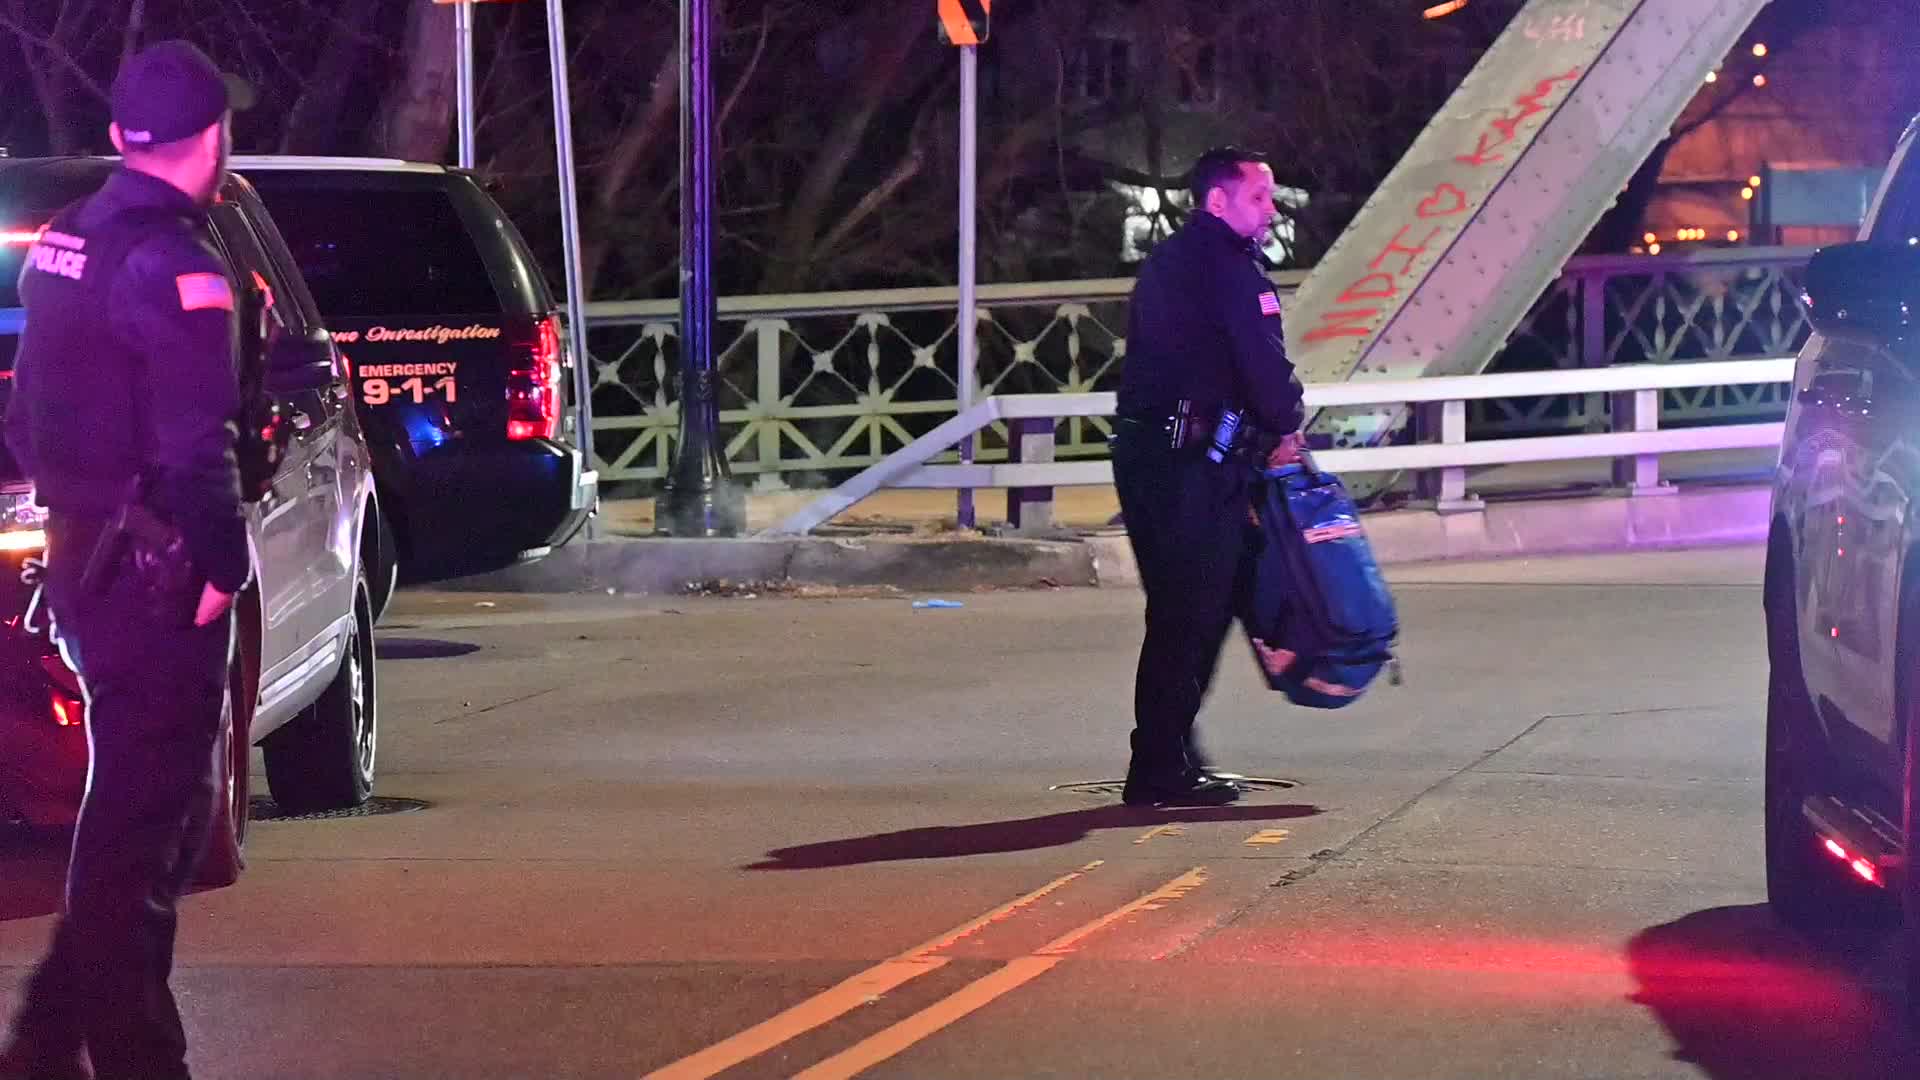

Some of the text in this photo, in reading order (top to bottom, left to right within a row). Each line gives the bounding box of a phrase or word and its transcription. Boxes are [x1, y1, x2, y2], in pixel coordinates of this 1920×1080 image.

[365, 324, 500, 344] Investigation
[359, 362, 457, 377] EMERGENCY
[362, 376, 456, 405] 9-1-1
